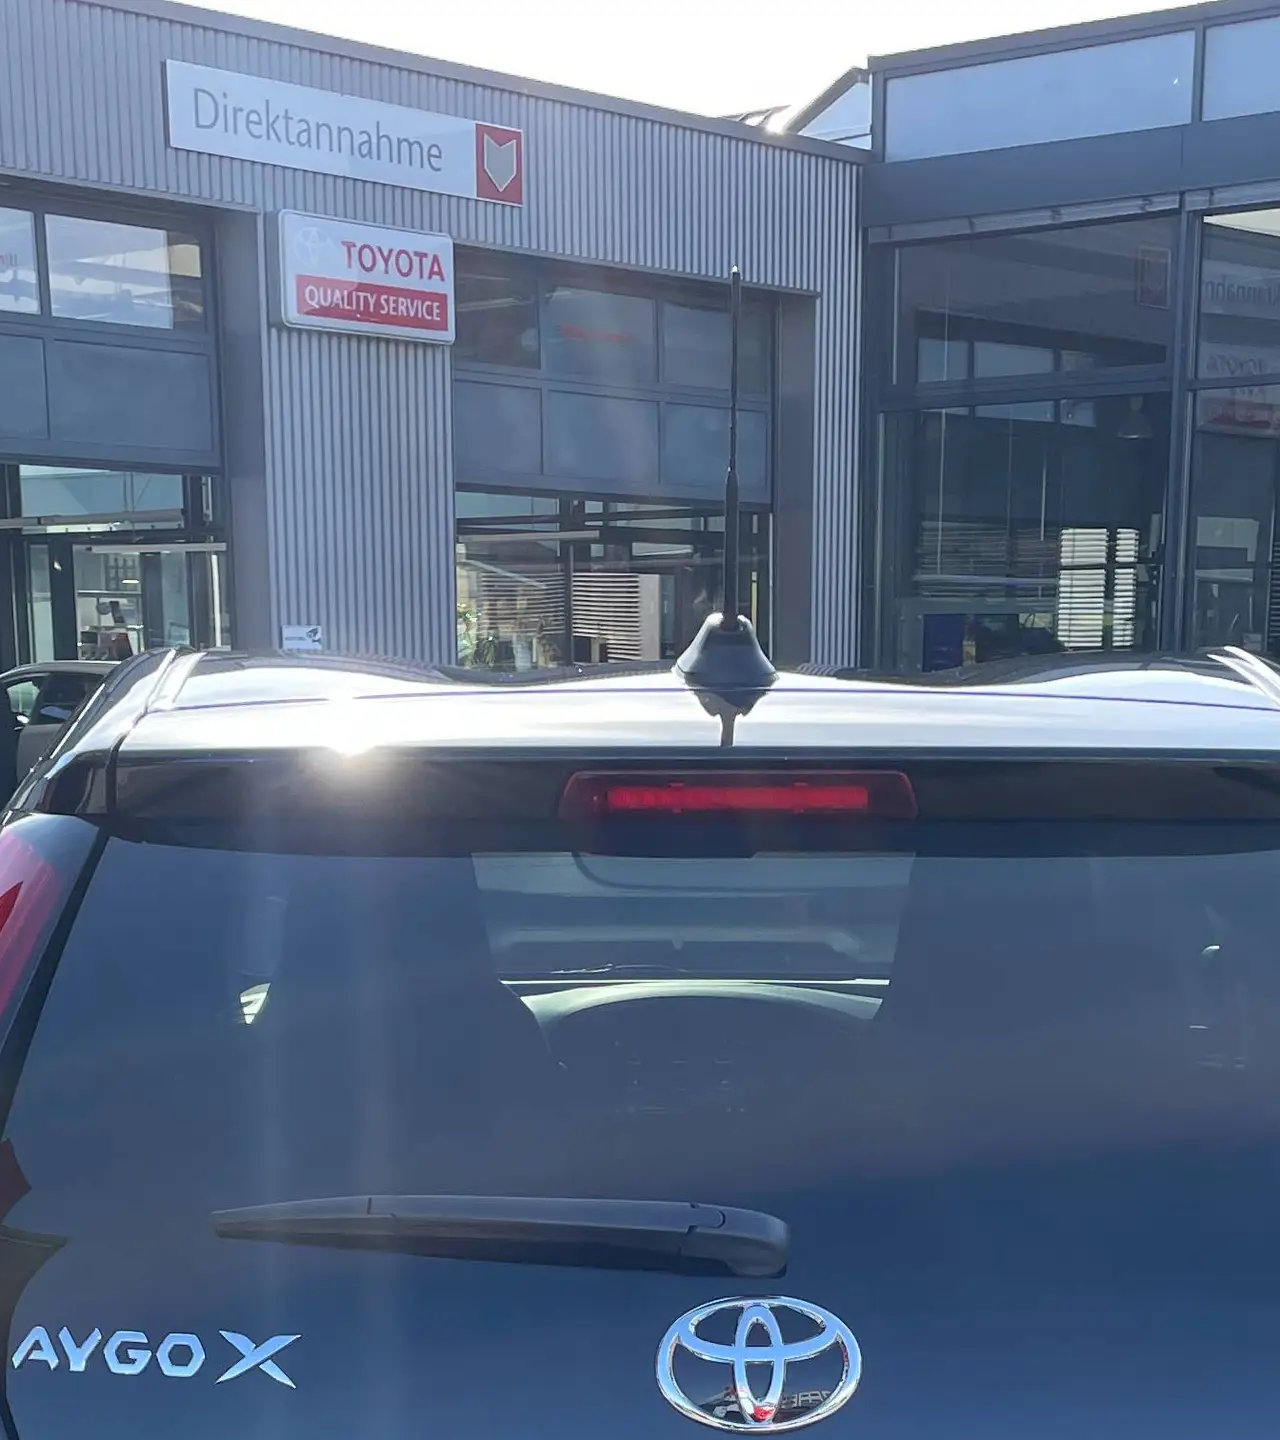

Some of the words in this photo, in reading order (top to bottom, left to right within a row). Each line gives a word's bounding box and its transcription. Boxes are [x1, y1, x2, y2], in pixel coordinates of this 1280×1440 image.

[193, 87, 443, 172] Direktannahme
[341, 240, 445, 282] TOYOTA
[304, 285, 378, 313] QUALITY
[380, 294, 441, 321] SERVICE
[11, 1325, 207, 1378] AYGO
[213, 1329, 303, 1390] X
